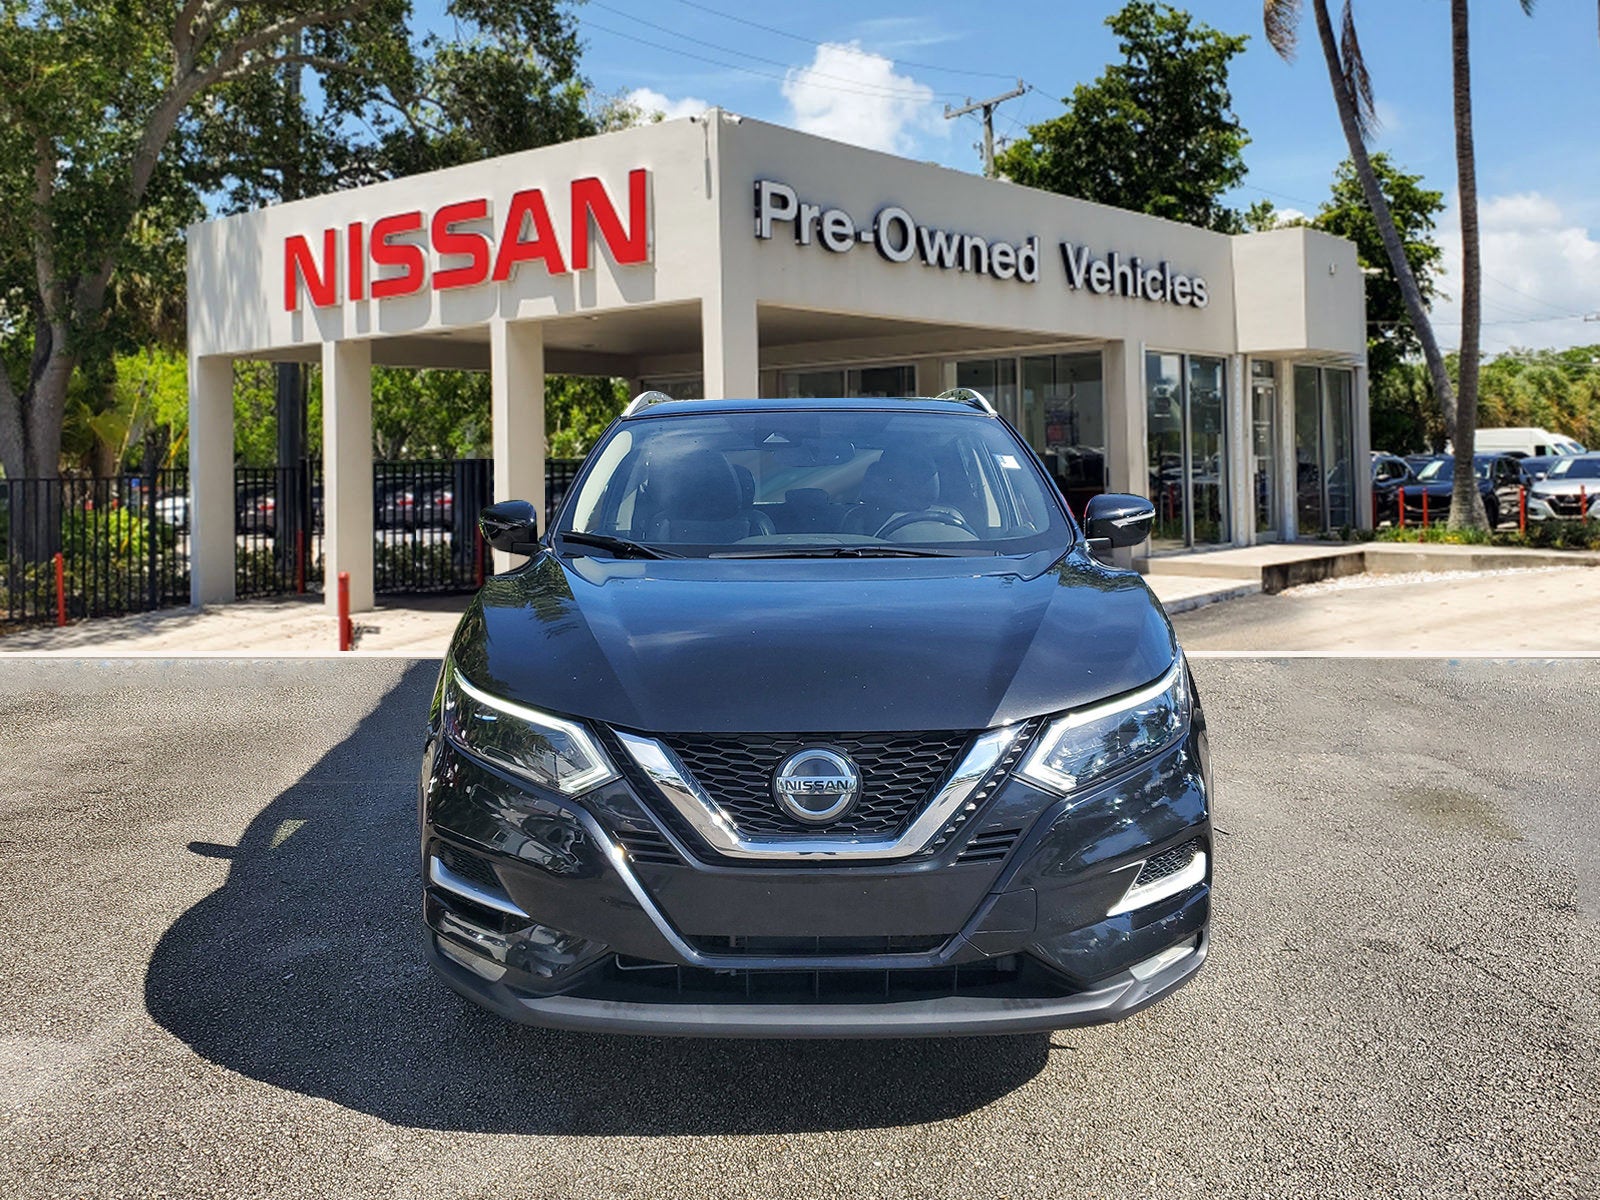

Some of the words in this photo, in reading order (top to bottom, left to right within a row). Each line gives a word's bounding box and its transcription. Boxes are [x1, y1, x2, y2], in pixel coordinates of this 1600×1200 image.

[284, 168, 649, 311] NISSAN
[755, 179, 1040, 284] Pre-Owned
[1060, 241, 1209, 309] Vehicles
[785, 779, 848, 791] NISSAN
